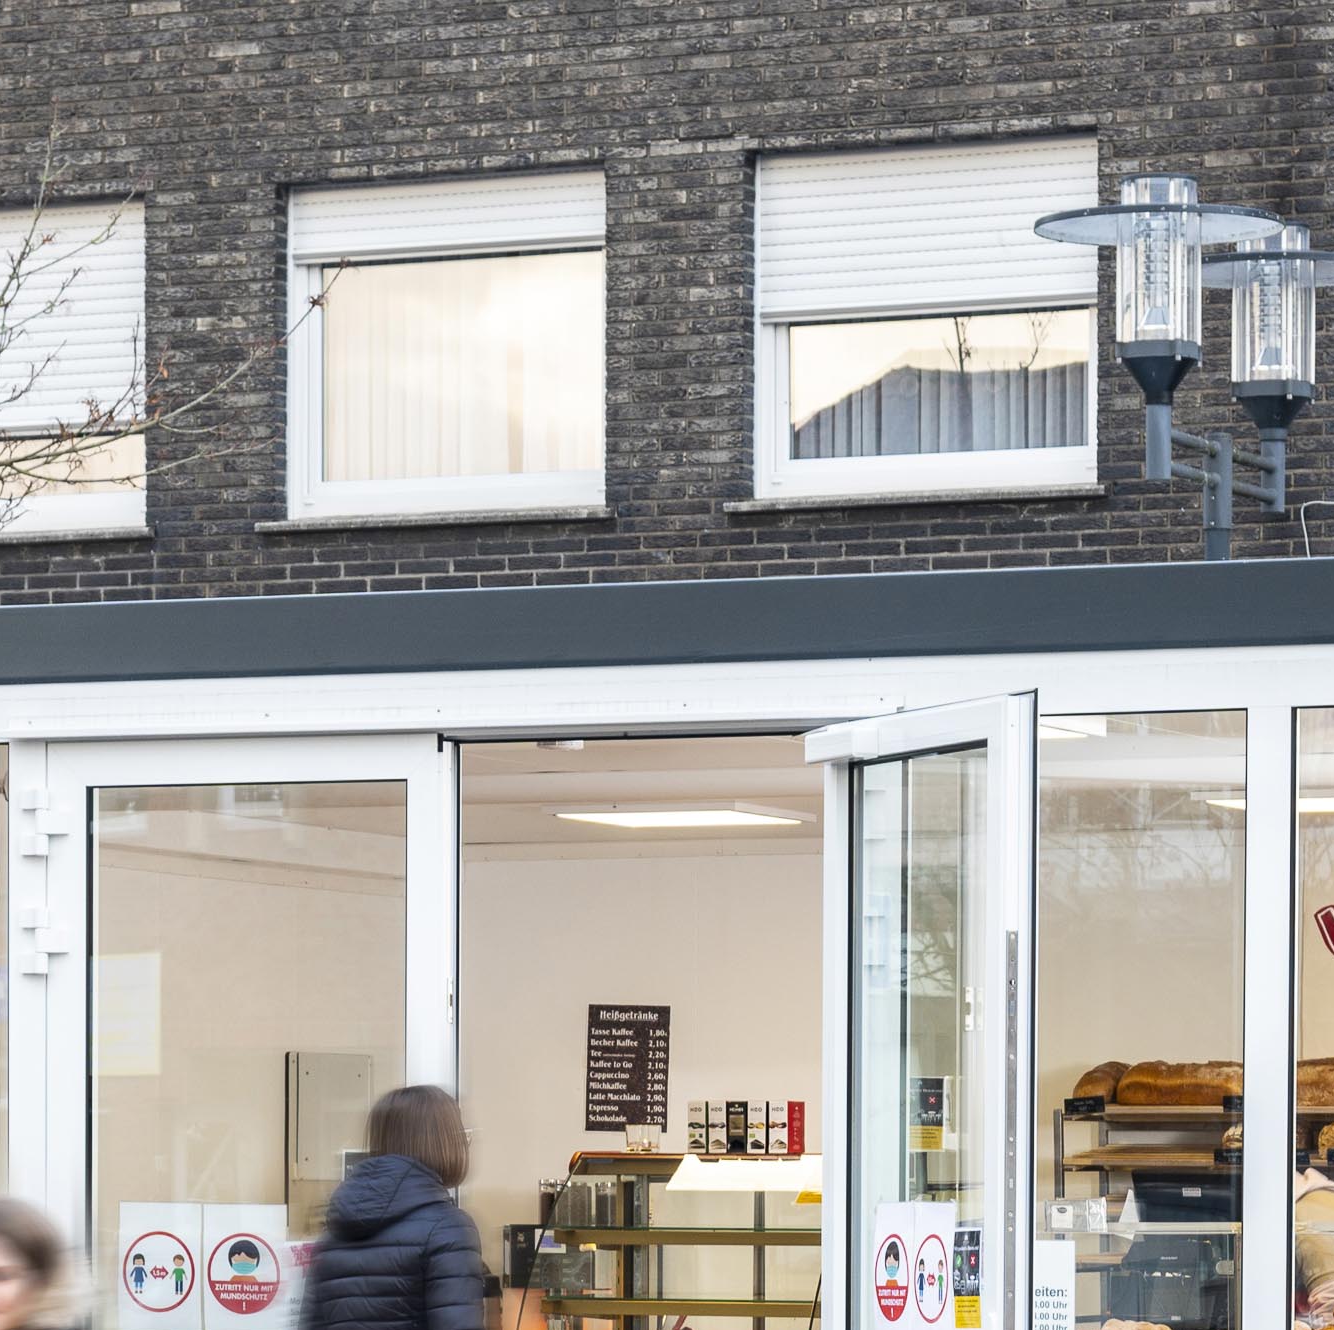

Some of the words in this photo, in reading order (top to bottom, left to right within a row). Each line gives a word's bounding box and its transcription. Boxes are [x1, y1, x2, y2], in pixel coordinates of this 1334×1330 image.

[599, 1009, 659, 1022] Heißgetränke
[591, 1028, 610, 1036] Tasse
[612, 1028, 634, 1036] Kaffee
[590, 1038, 615, 1046] Becher
[616, 1039, 638, 1047] Kaffee
[590, 1060, 612, 1068] Kaffee
[623, 1061, 633, 1069] Go
[589, 1071, 630, 1080] Cappuccino
[589, 1082, 627, 1090] Milchkaffee
[589, 1092, 606, 1100] Latte
[607, 1093, 641, 1101] Macchiato
[588, 1103, 618, 1112] Espresso
[588, 1114, 627, 1122] Schokolade
[215, 1283, 242, 1292] ZUTRITT
[244, 1284, 259, 1292] NUR
[261, 1285, 274, 1293] MIT
[220, 1292, 268, 1301] MUNDSCHUTZ
[1052, 1300, 1068, 1309] Uhr
[1052, 1312, 1068, 1320] Uhr
